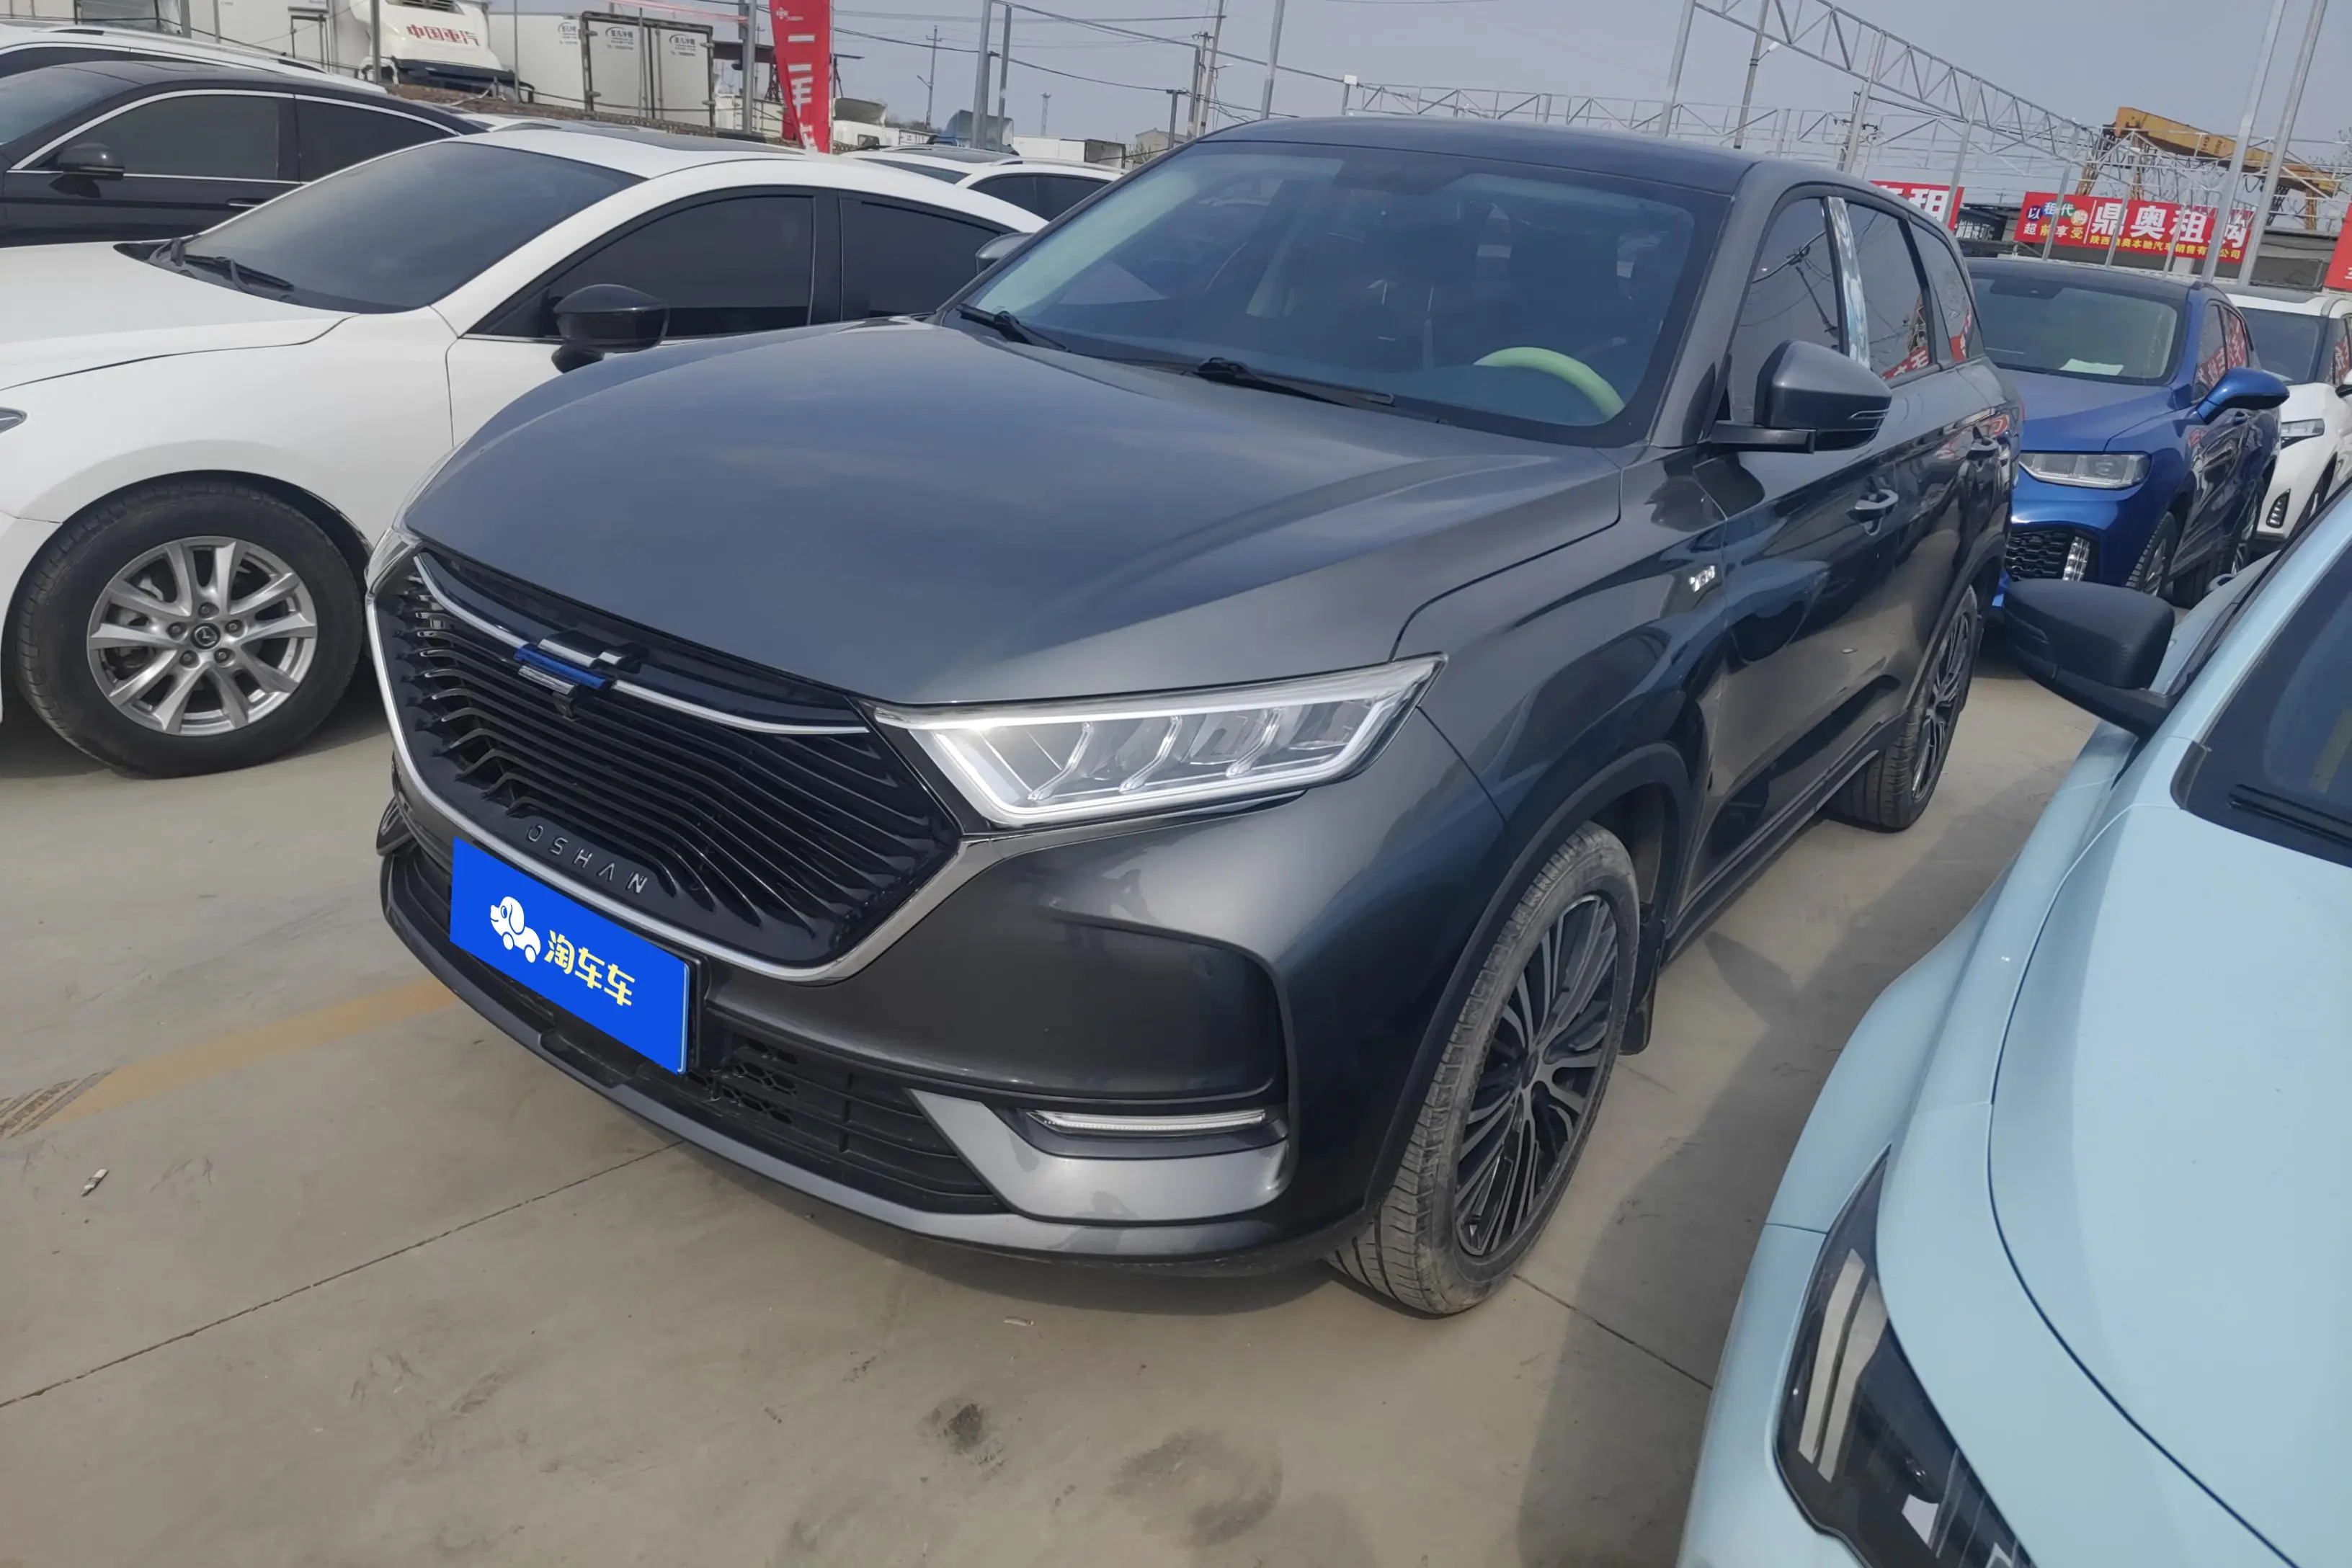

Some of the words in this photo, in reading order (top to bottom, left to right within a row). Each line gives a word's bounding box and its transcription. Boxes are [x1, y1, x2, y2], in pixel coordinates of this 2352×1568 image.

[406, 24, 480, 48] 中国重汽
[2023, 223, 2083, 239] 超前享受
[2090, 235, 2241, 259] 陕西奥本驰汽车销售有公司
[527, 824, 648, 894] OSHAN
